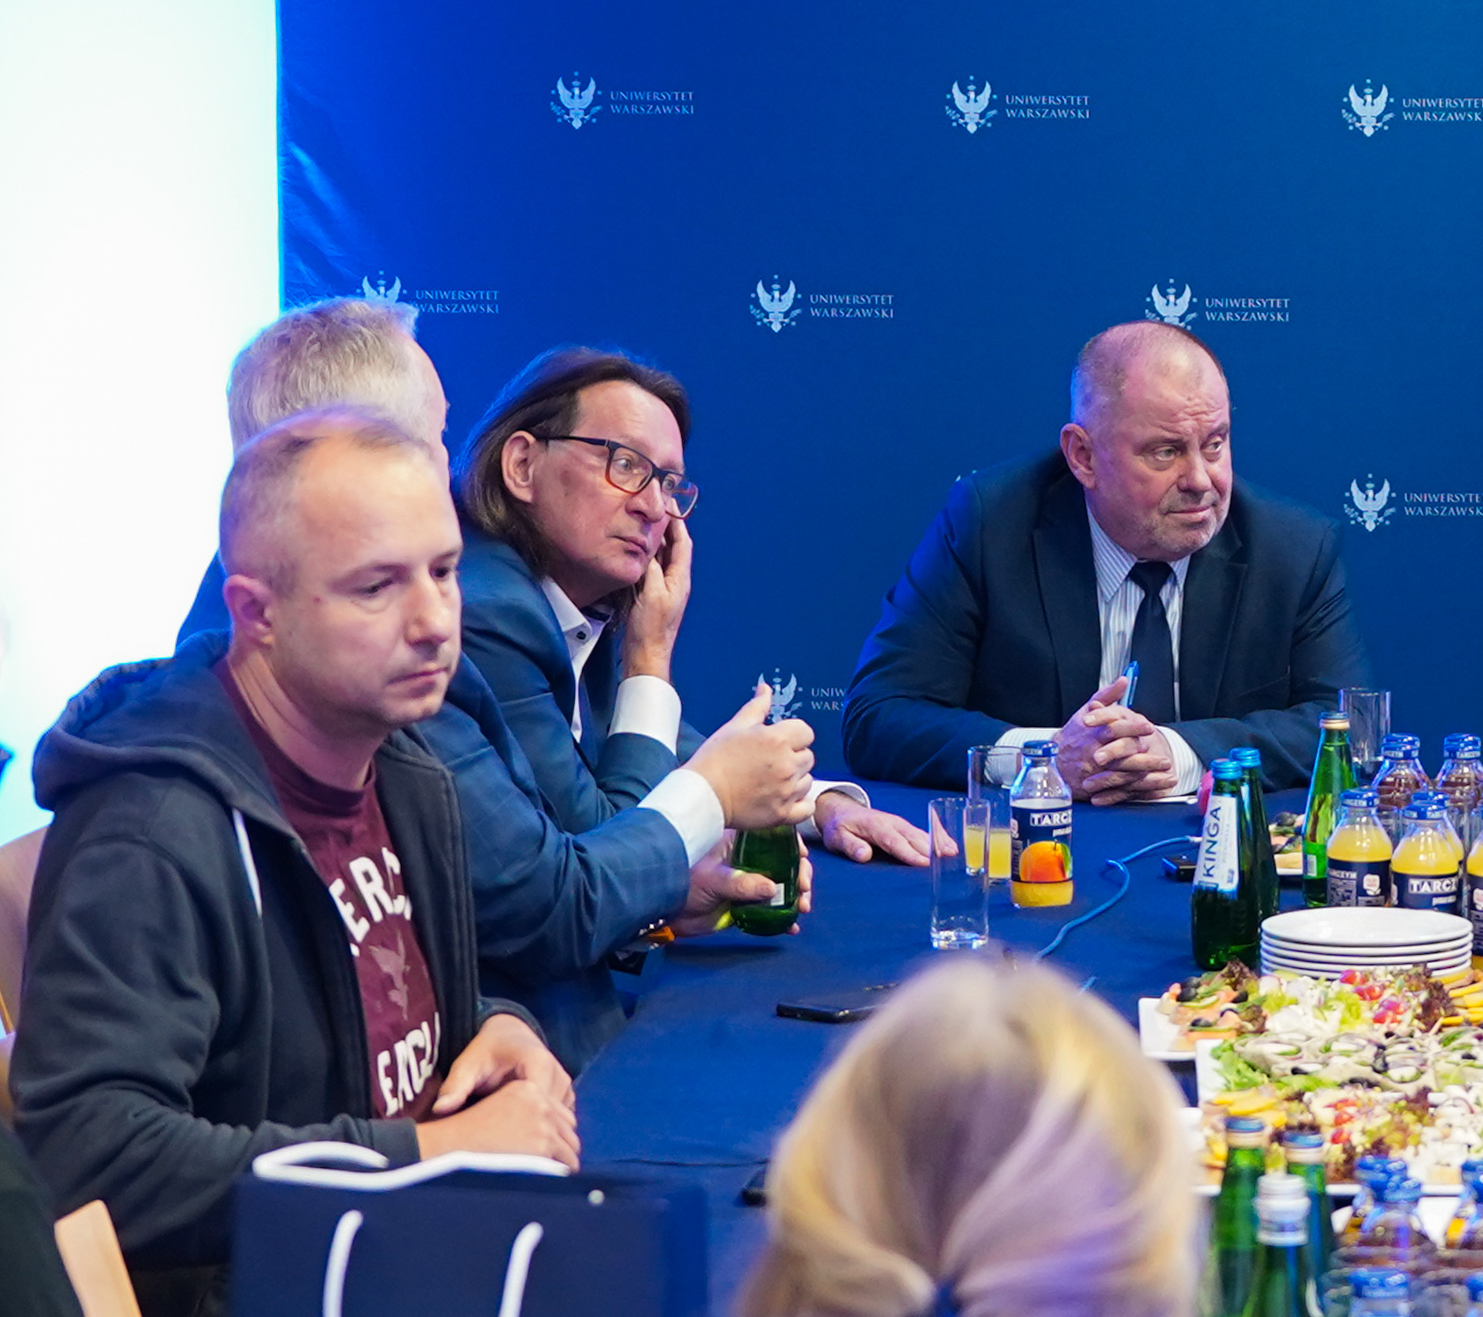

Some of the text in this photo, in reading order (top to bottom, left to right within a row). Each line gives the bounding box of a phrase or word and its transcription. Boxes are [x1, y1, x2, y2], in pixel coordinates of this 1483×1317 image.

[610, 91, 693, 101] UNIWERSYTET
[1005, 95, 1089, 106] UNIWERSYTET
[610, 104, 694, 115] WARSZAWSKI
[1005, 108, 1090, 119] WARSZAWSKI
[415, 289, 499, 301] UNIWERSYTET
[809, 294, 894, 305] UNIWERSYTET
[1205, 298, 1289, 309] UNIWERSYTET
[810, 307, 894, 319] WARSZAWSKI
[1205, 311, 1290, 322] WARSZAWSKI
[1202, 805, 1222, 878] KINGA
